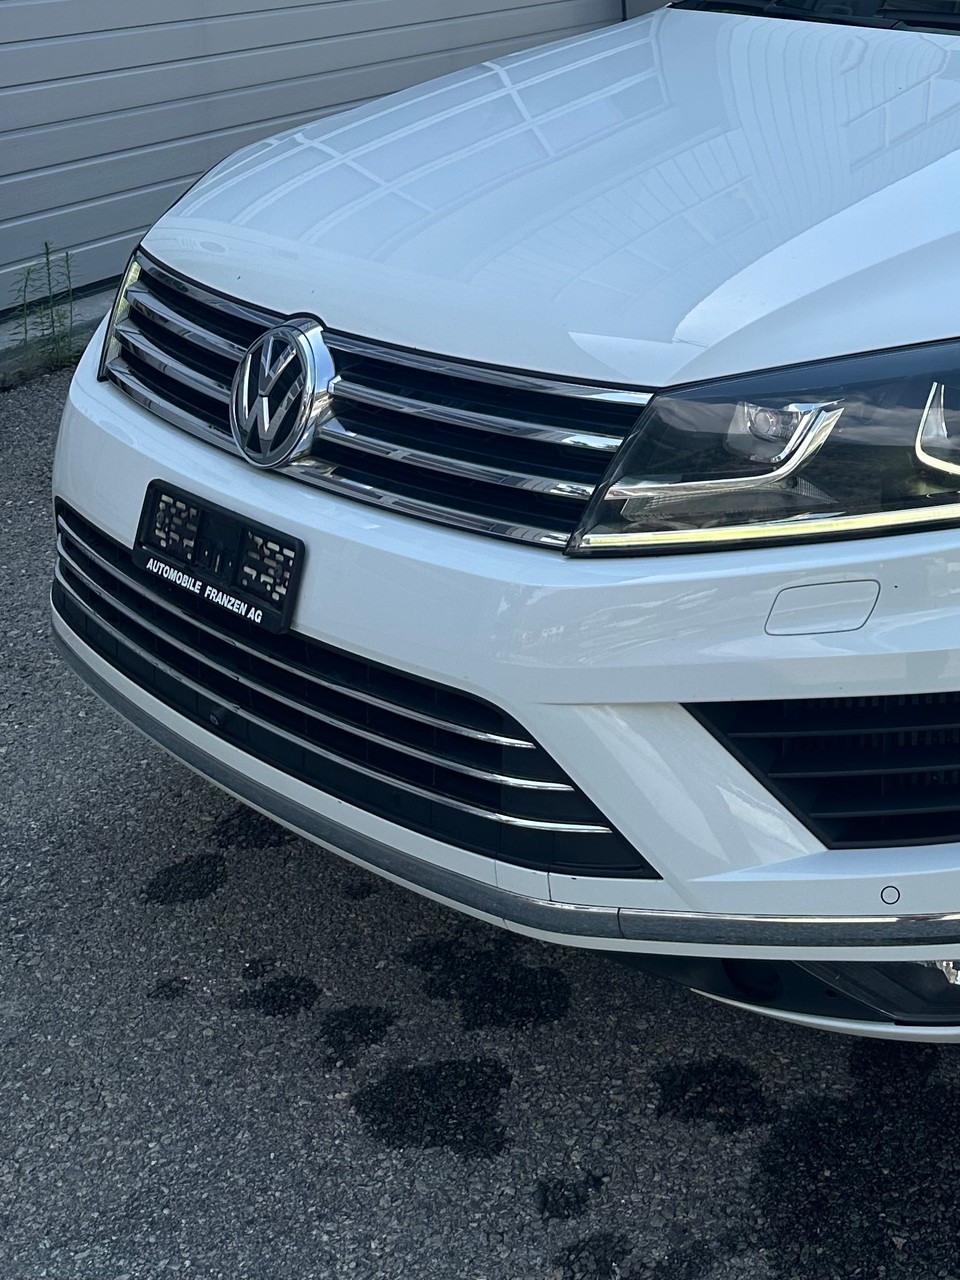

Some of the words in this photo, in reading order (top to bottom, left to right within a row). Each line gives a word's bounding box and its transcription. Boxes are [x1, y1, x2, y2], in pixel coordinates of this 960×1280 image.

[146, 557, 202, 594] AUTOMOBILE
[204, 585, 248, 616] FRANZEN
[247, 607, 263, 624] AG
